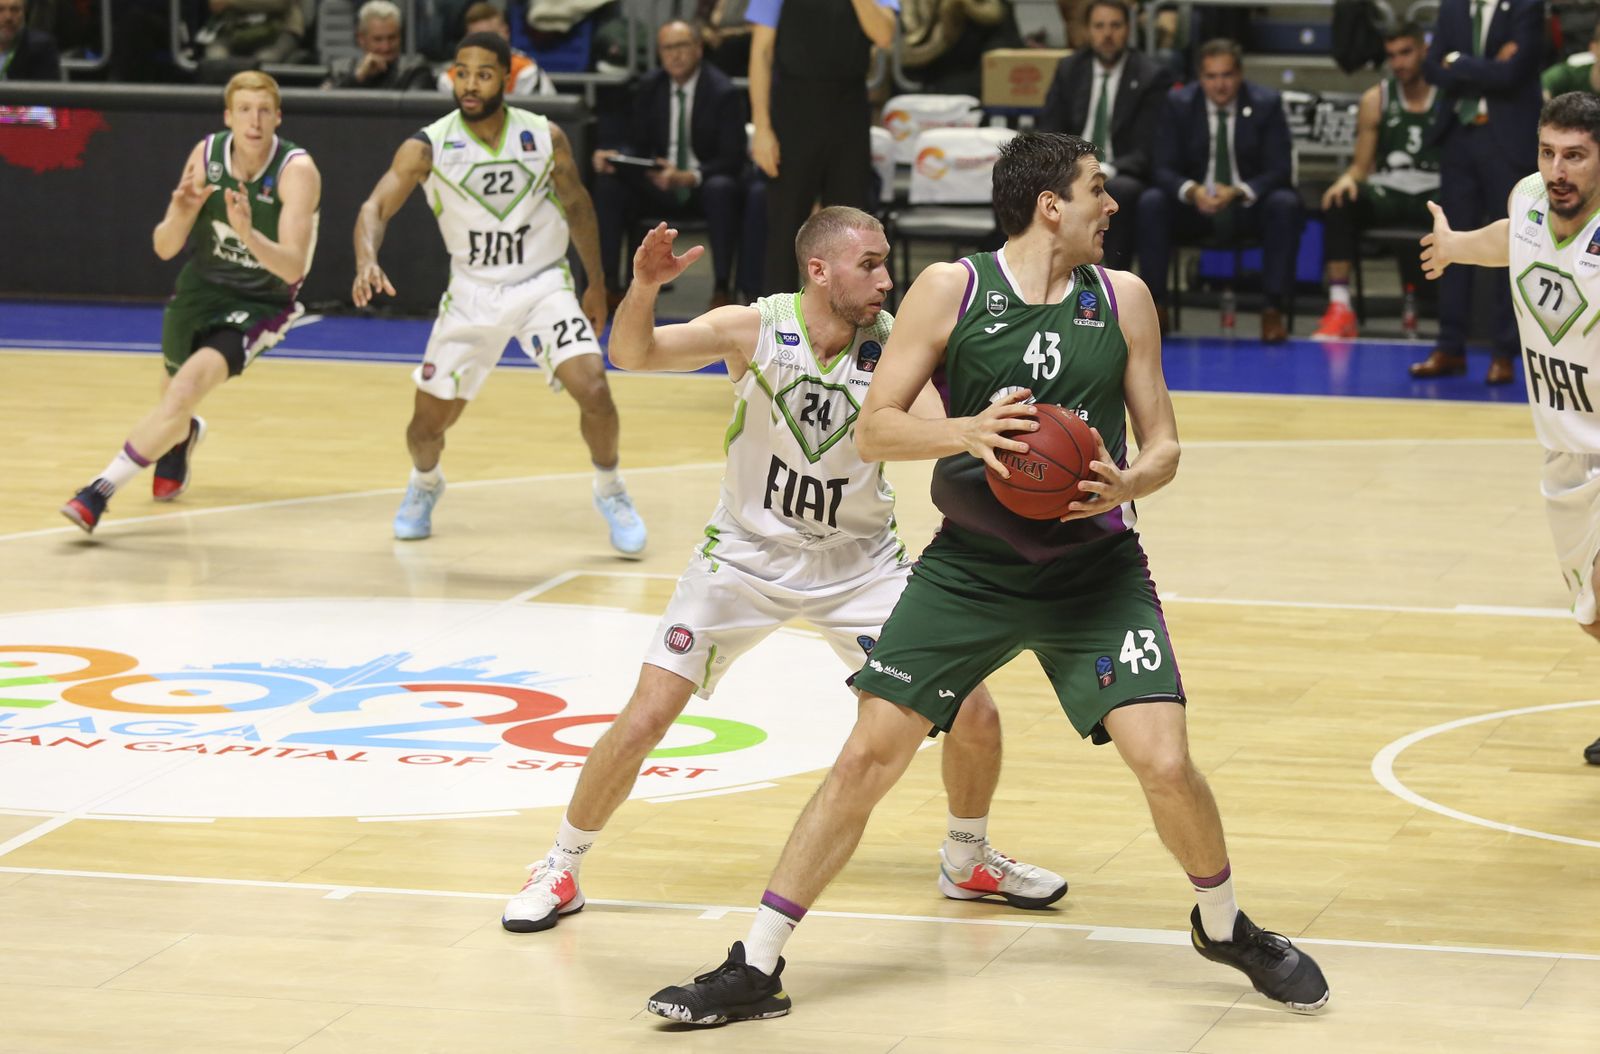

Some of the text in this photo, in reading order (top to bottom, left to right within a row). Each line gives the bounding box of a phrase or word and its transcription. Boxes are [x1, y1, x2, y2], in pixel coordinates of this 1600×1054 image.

[1406, 125, 1422, 154] 3
[482, 170, 515, 196] 22
[468, 224, 532, 267] FIAT
[1537, 277, 1564, 311] 77
[553, 317, 592, 349] 22
[1023, 331, 1062, 381] 43
[1525, 347, 1594, 413] FIAT
[800, 392, 831, 432] 24
[763, 453, 850, 529] FIAT
[669, 630, 691, 648] FIAT
[1119, 629, 1162, 675] 43
[123, 740, 370, 763] CAPITAL
[397, 753, 493, 767] OF
[506, 758, 720, 779] SPRT
